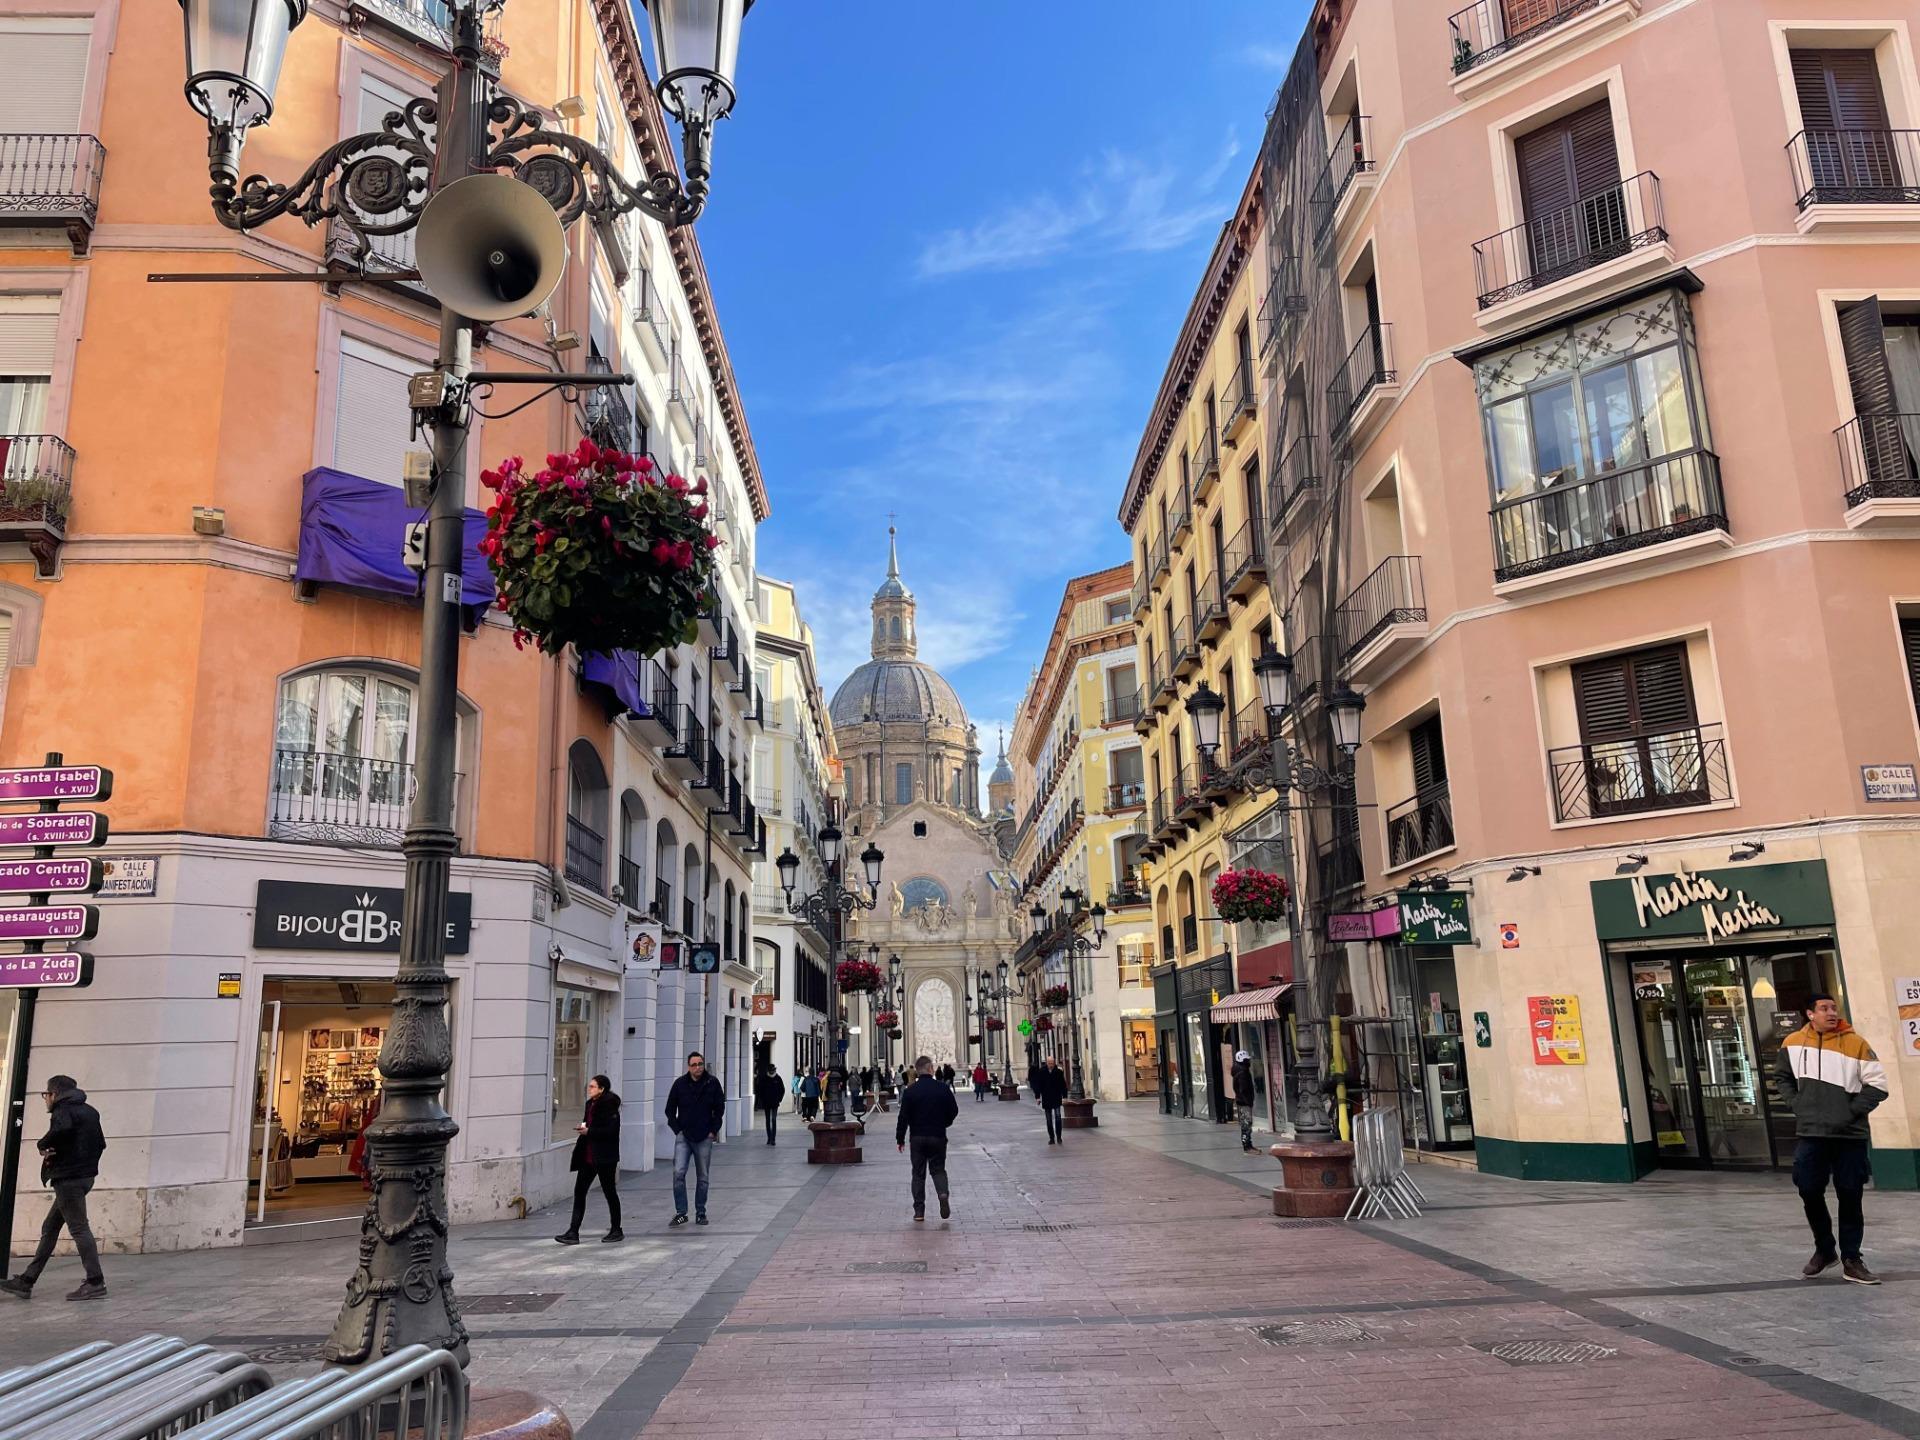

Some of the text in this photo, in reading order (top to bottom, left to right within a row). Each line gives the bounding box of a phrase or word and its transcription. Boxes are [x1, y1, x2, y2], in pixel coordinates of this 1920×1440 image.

[13, 773, 51, 783] Santa
[55, 771, 95, 781] Isabel
[1881, 769, 1912, 779] CALLE
[70, 785, 94, 793] XVII)
[1867, 784, 1891, 795] ESPOZ
[1892, 784, 1897, 794] Y
[11, 821, 23, 829] de
[27, 816, 90, 828] Sobradiel
[43, 830, 89, 840] XVIII-XIX)
[0, 862, 86, 876] cado Central
[122, 862, 148, 871] CALLE
[66, 877, 85, 886] XX)
[64, 924, 80, 933] III)
[277, 914, 338, 937] BIJOU
[6, 957, 75, 970] de La Zuda
[56, 972, 75, 981] XV)
[1906, 988, 1920, 999] ES
